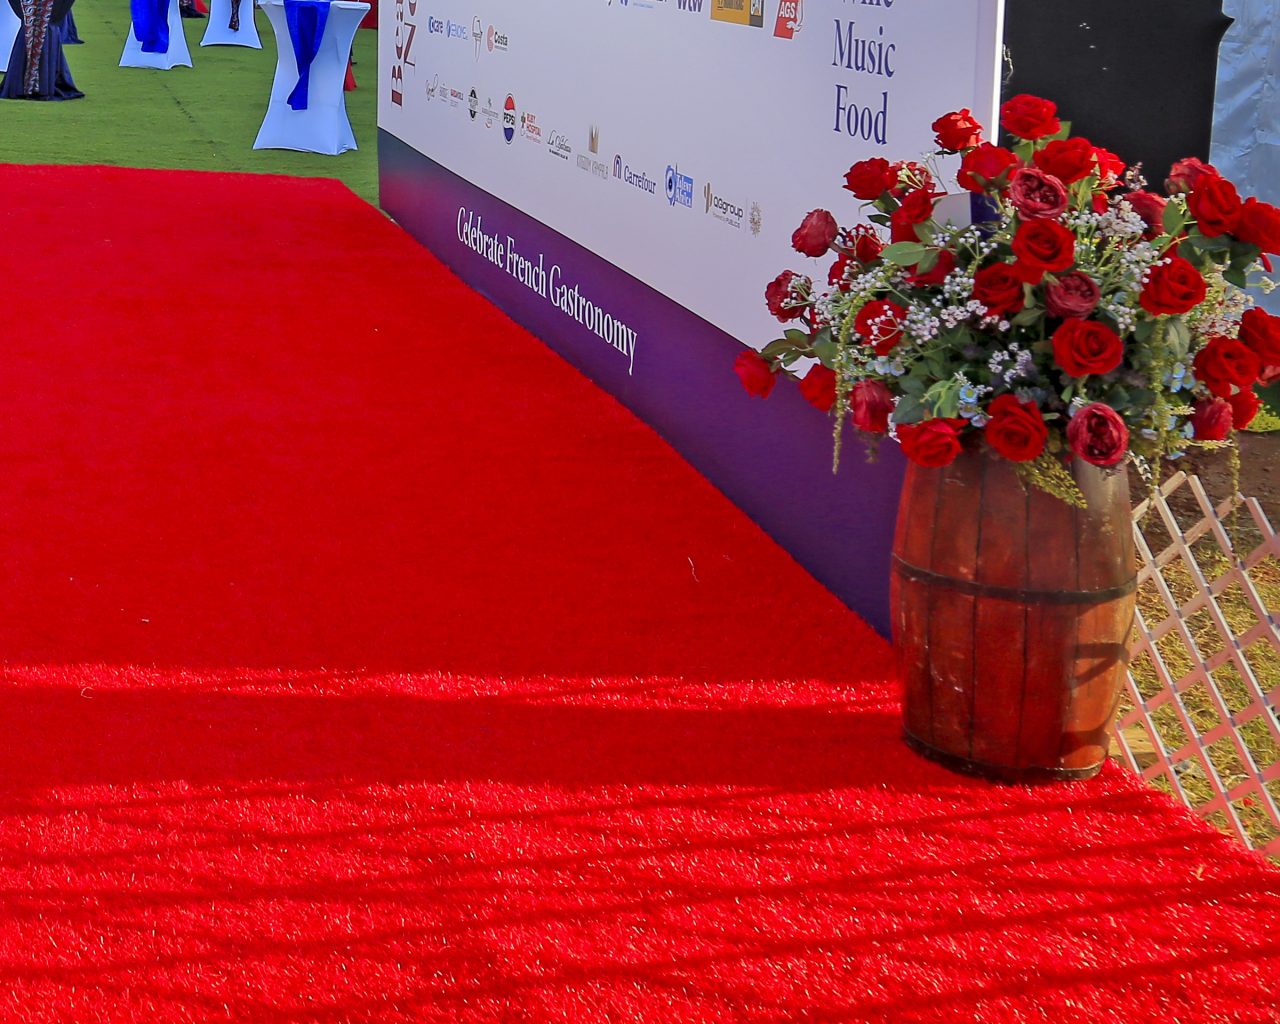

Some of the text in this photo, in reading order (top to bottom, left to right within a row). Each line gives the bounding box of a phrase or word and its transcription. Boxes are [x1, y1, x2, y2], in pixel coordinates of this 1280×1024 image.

[778, 1, 796, 19] AGS
[494, 31, 508, 47] Costa
[832, 19, 896, 77] Music
[503, 112, 515, 125] PEPSI
[833, 84, 888, 145] Food
[624, 165, 656, 195] Carrefour
[457, 206, 638, 376] Celebrate French Gastronomy
